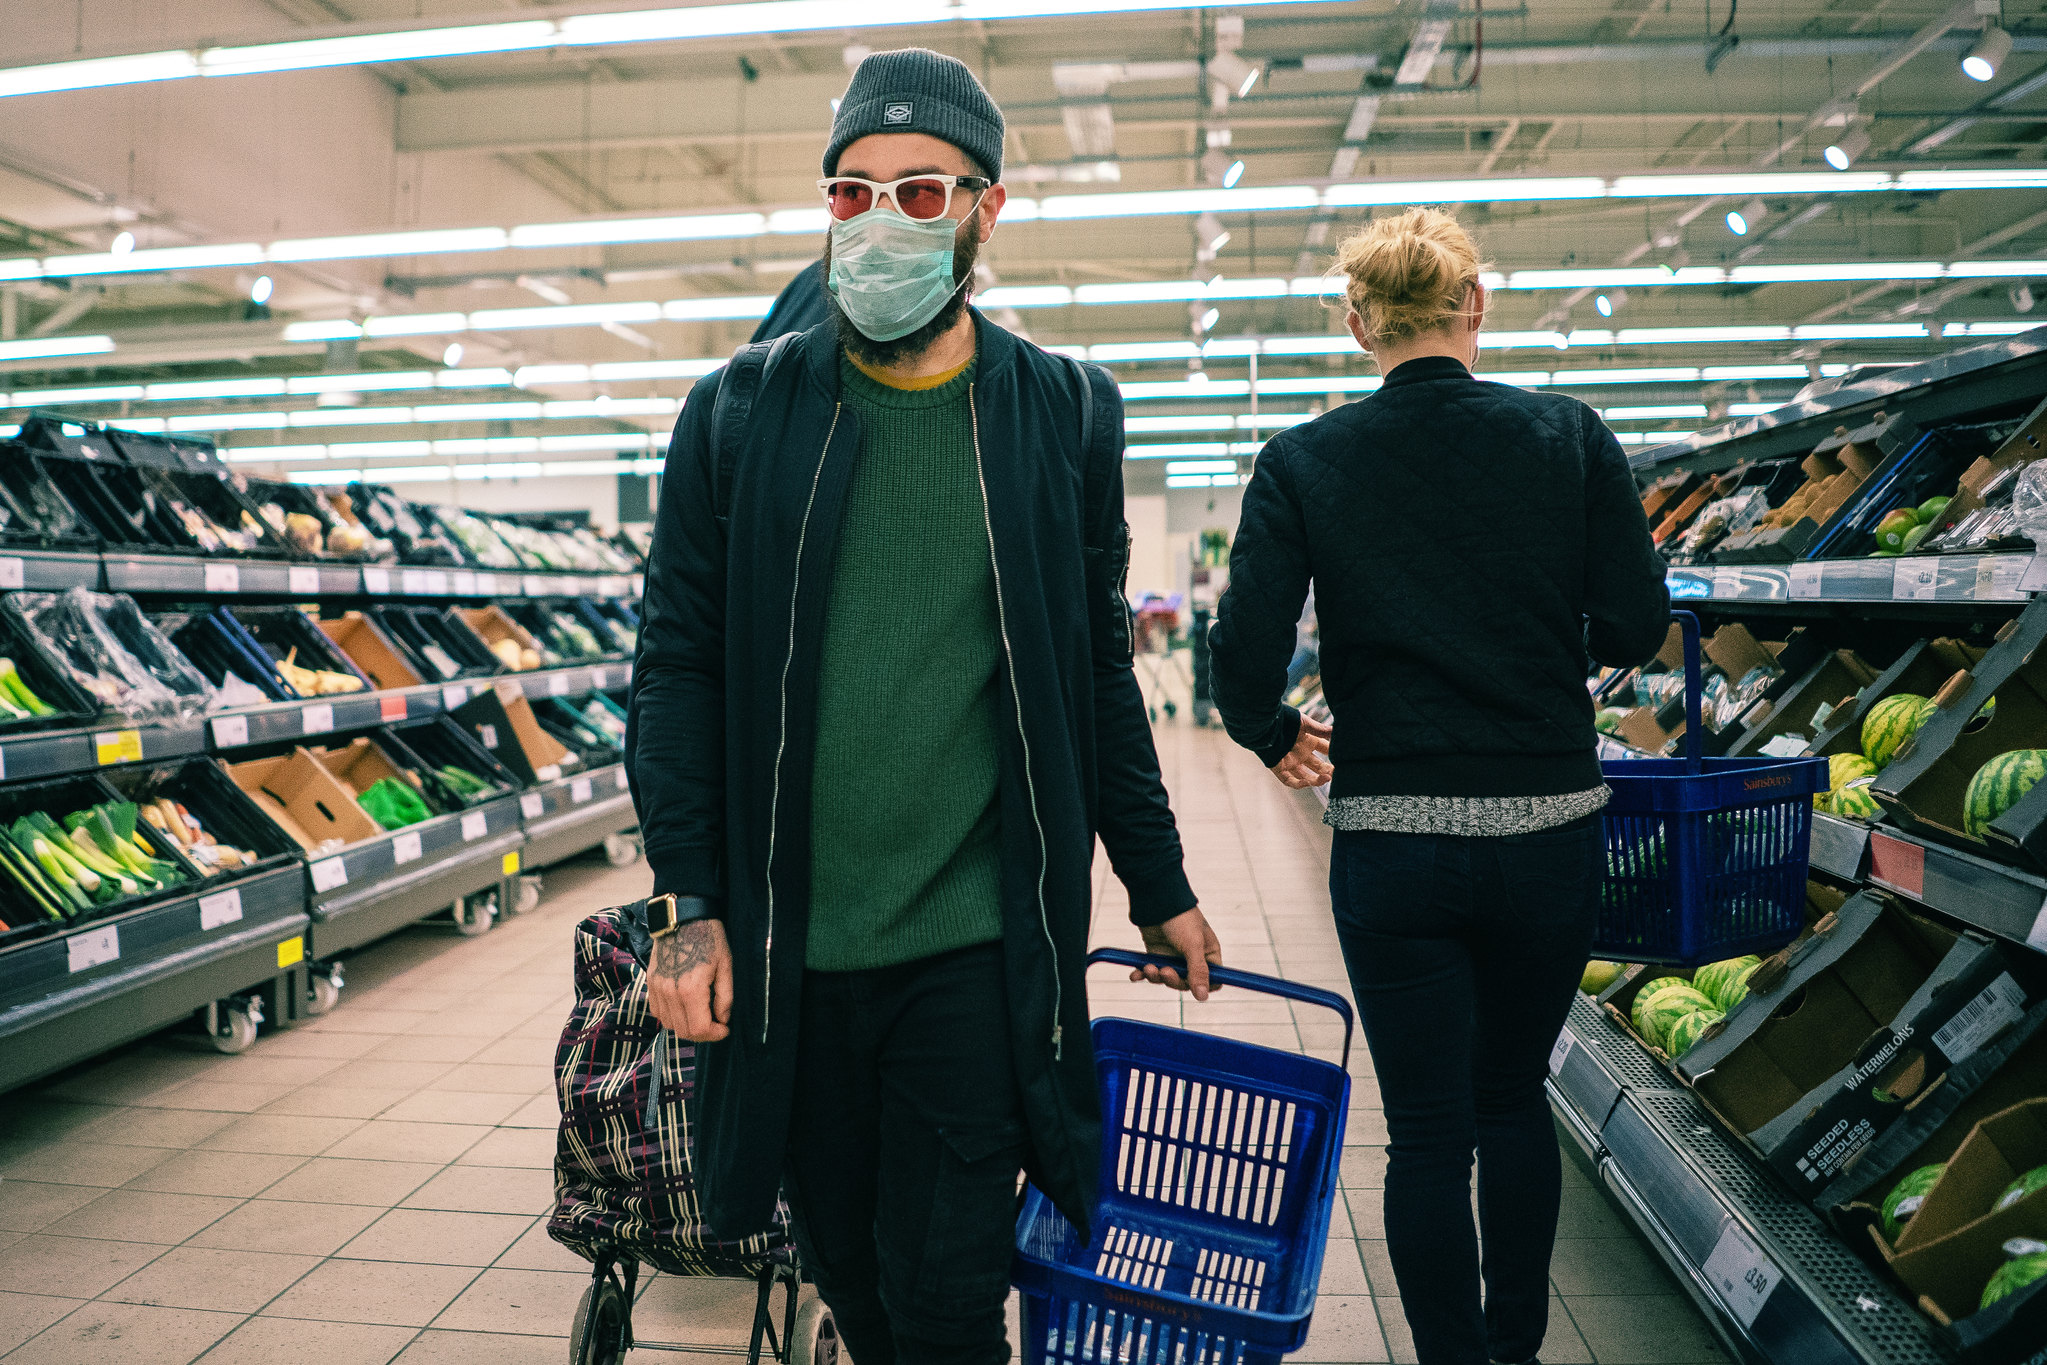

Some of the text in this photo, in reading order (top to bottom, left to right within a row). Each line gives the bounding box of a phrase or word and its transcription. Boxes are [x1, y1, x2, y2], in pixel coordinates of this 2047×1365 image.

[1845, 1023, 1915, 1091] WATERMELONS
[1807, 1119, 1849, 1160] SEEDED
[1817, 1118, 1871, 1171] SEEDLESS
[1823, 1127, 1876, 1178] MAY CONTAIN FEW SEEDS
[1744, 1267, 1768, 1295] £3.50
